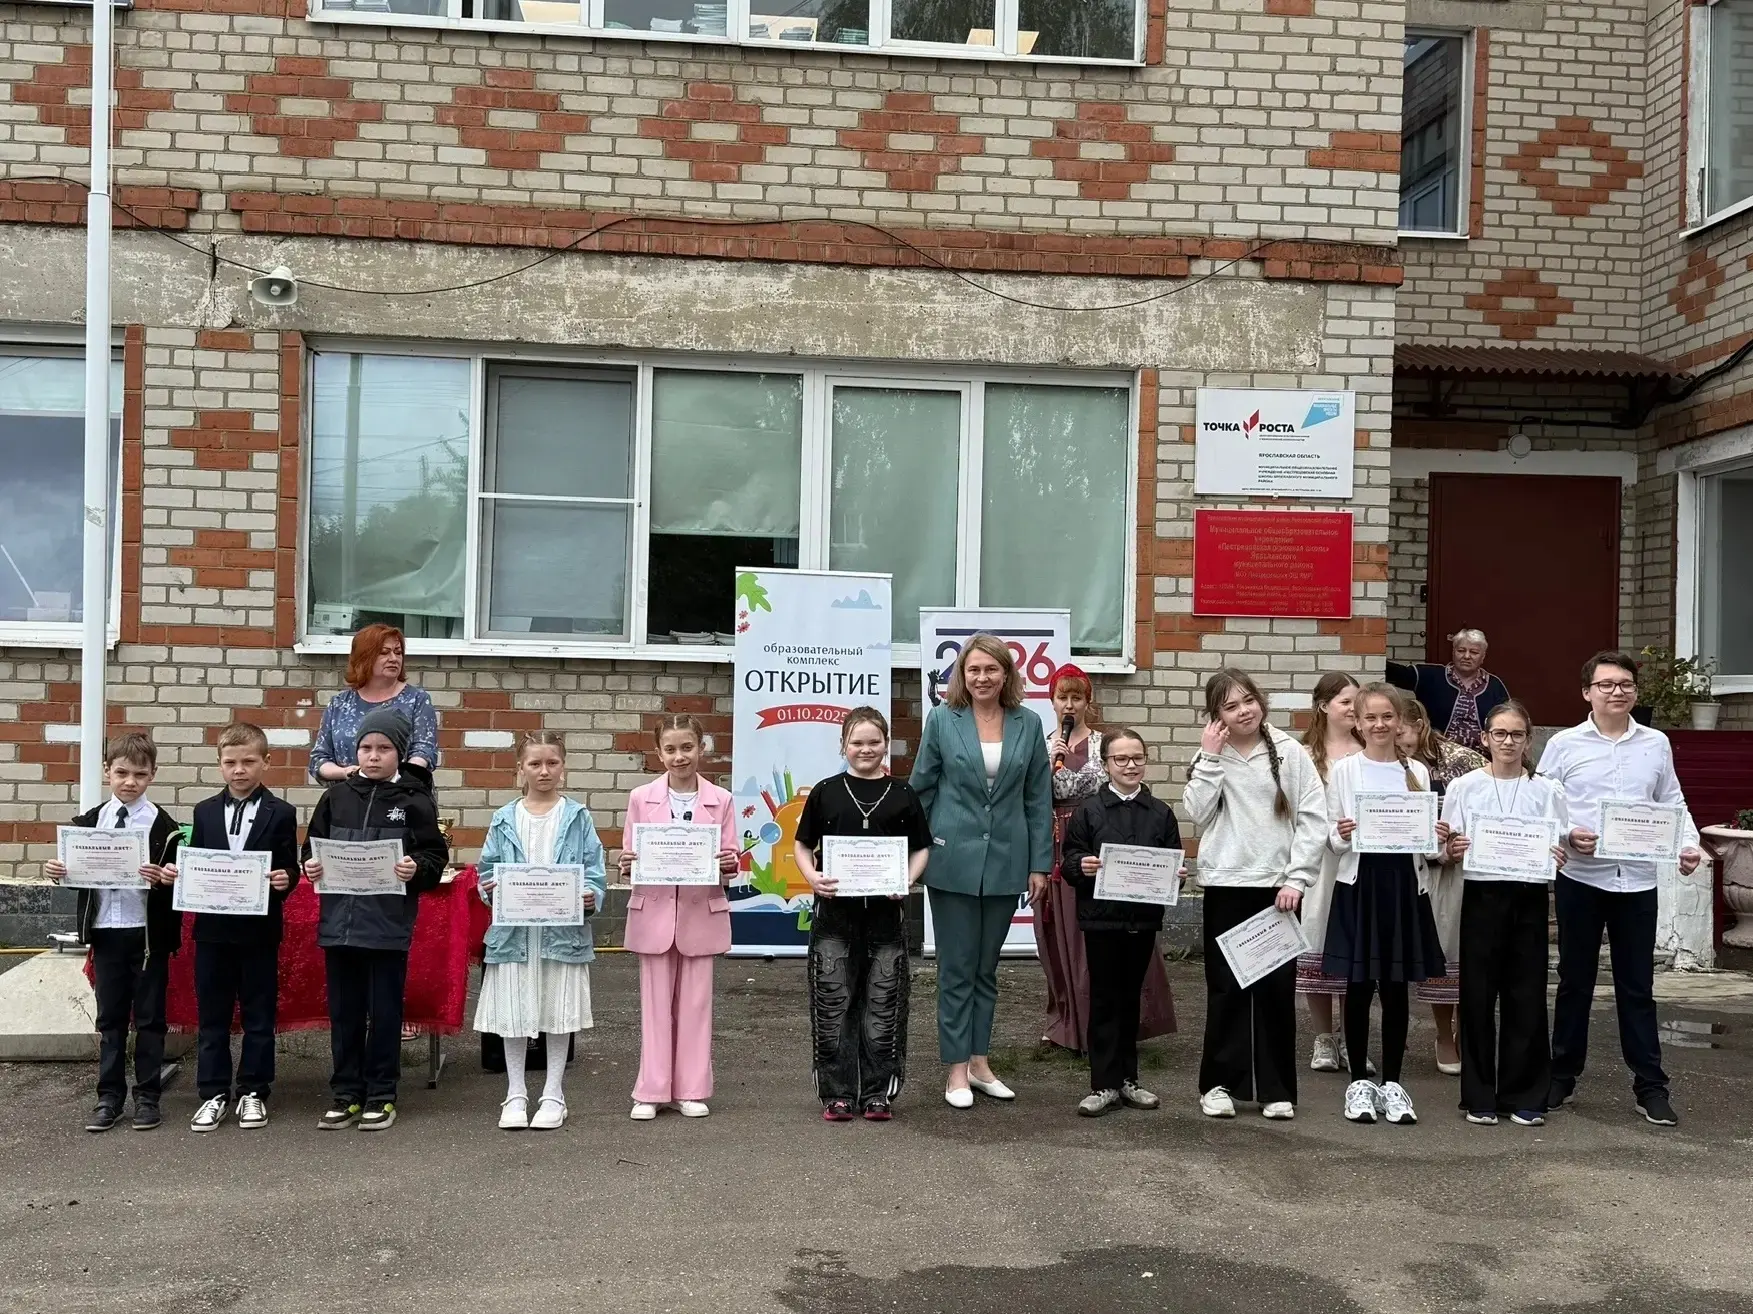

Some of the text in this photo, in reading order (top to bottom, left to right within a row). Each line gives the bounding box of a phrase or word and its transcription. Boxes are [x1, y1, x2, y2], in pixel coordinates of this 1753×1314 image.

[1203, 422, 1295, 433] ТОЧКА РОСТА
[763, 643, 863, 656] образовательный
[786, 656, 840, 666] комплекс
[745, 669, 880, 695] ОТКРЫТИЕ
